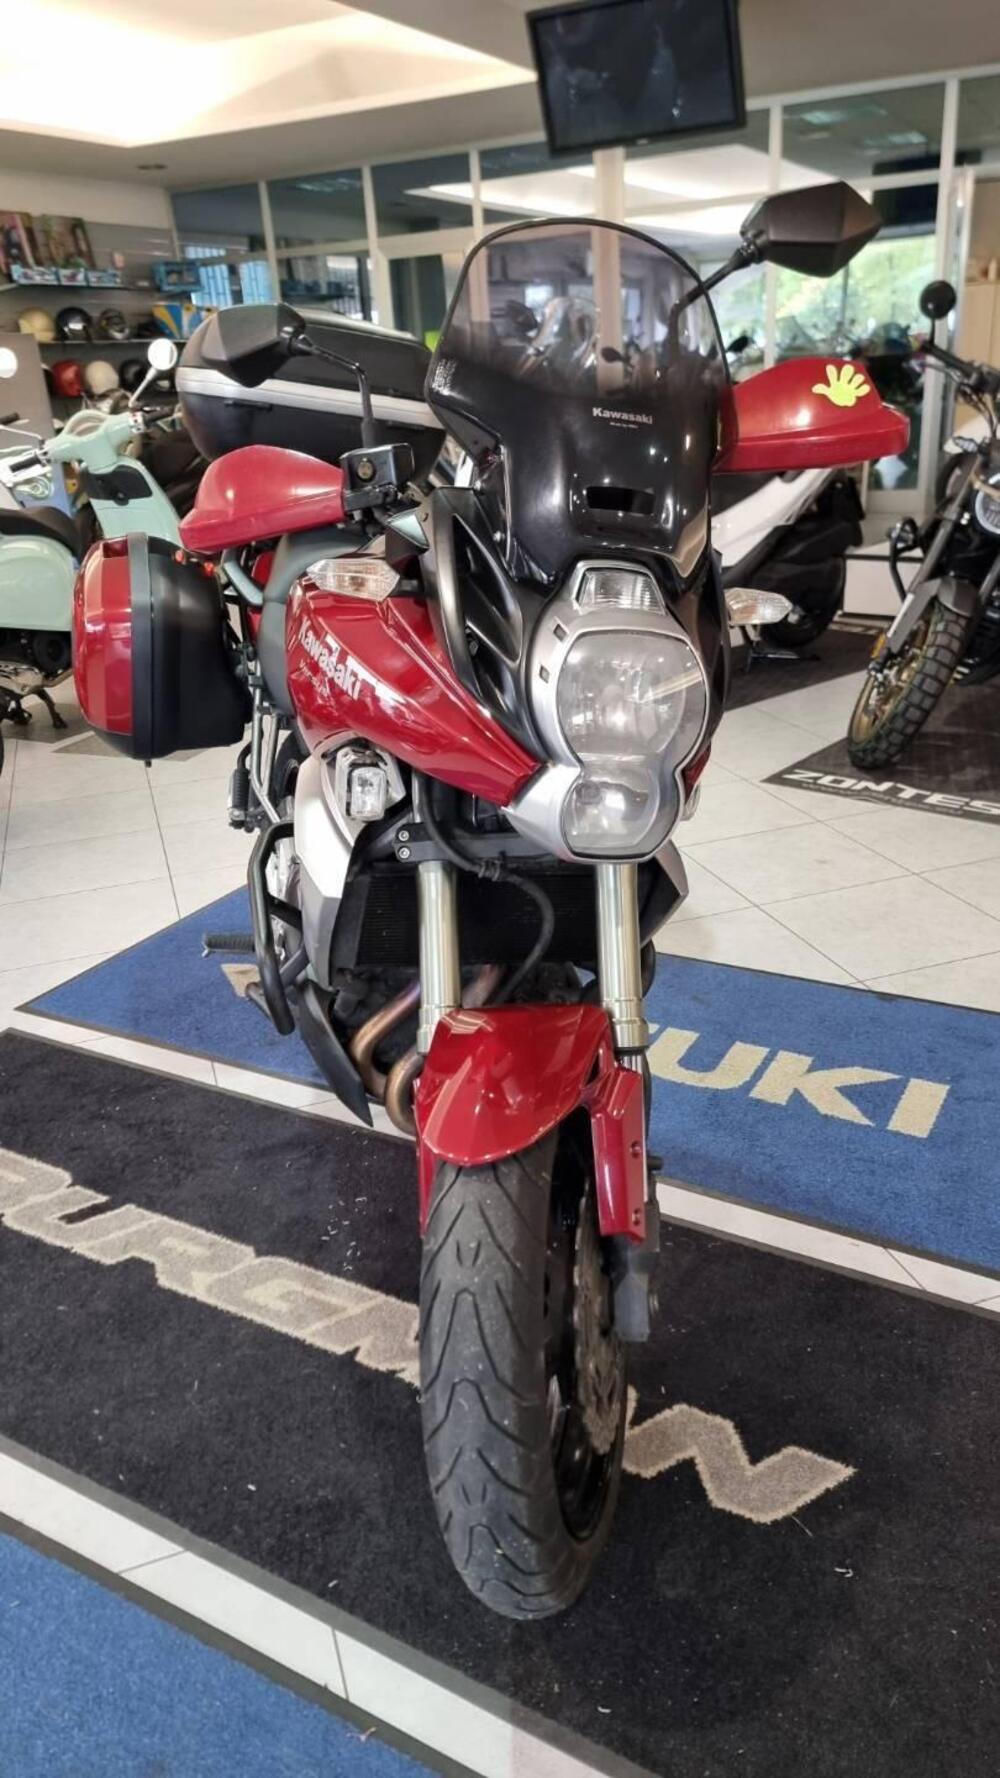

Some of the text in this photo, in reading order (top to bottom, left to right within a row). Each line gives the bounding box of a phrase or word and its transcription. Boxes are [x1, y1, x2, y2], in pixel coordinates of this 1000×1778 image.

[592, 407, 653, 424] Kawasaki
[298, 614, 379, 703] Kawasaki
[782, 769, 1000, 815] ZONTES
[647, 1022, 950, 1138] UKI
